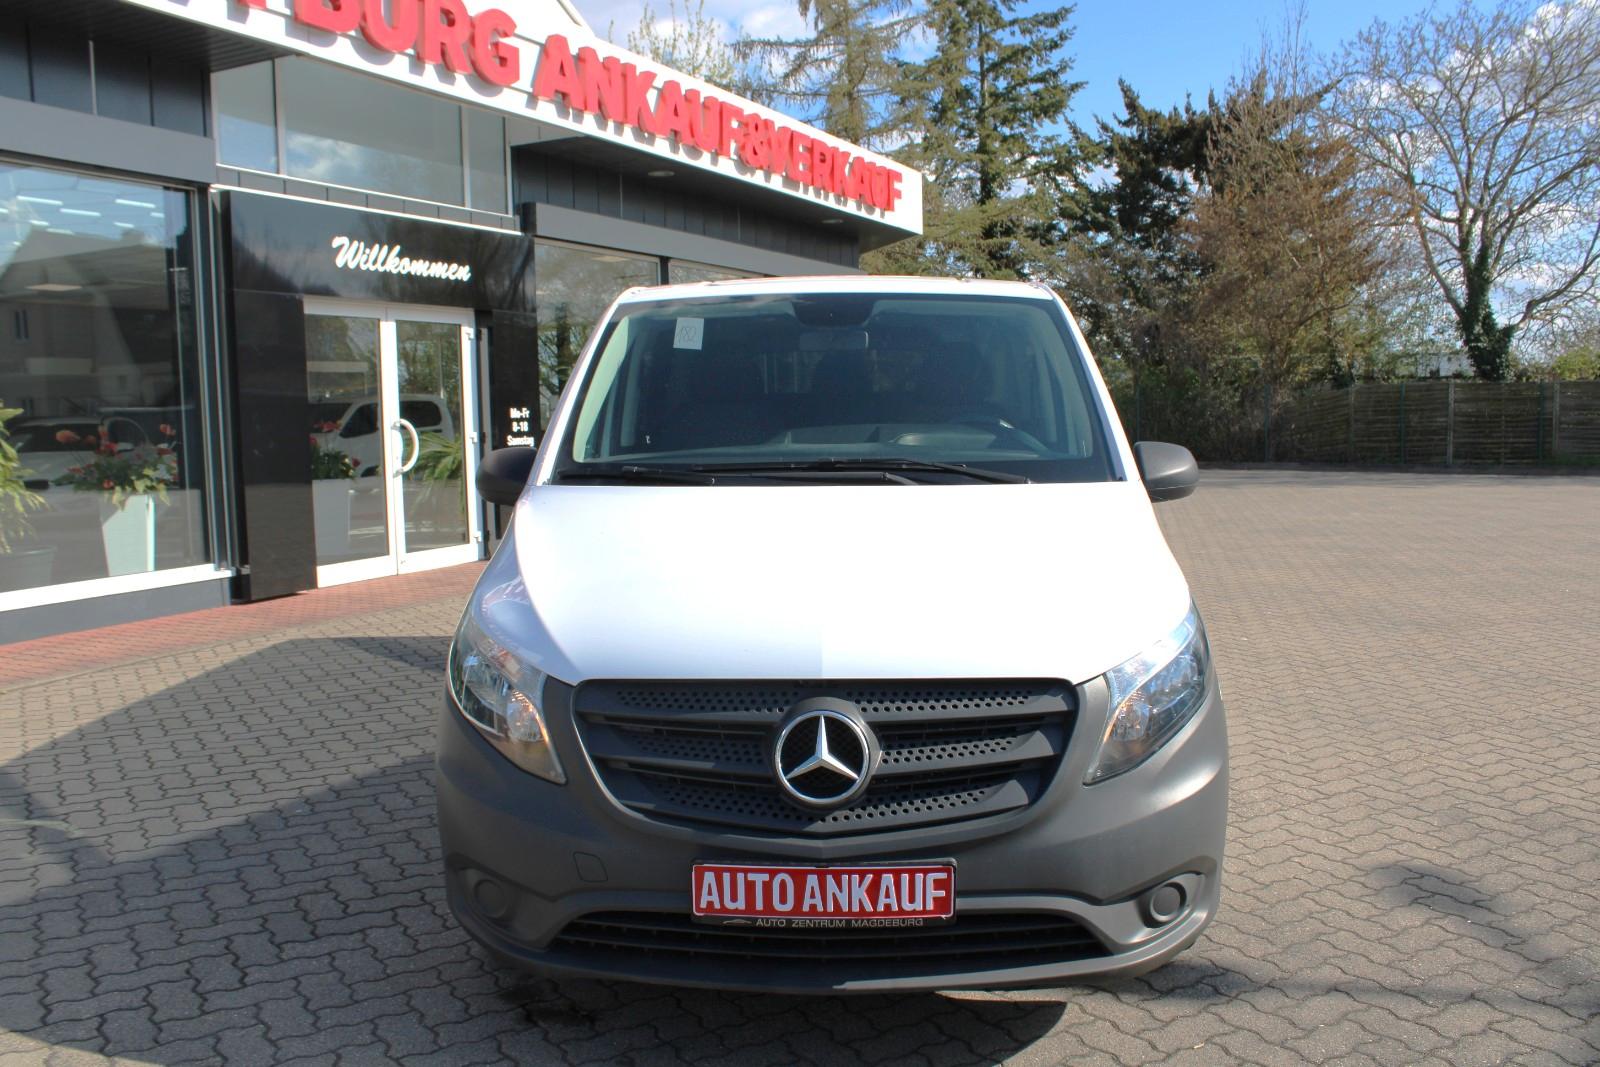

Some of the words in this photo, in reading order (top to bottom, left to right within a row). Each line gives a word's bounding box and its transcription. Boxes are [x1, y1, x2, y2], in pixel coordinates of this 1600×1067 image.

[237, 0, 520, 86] URG
[332, 236, 471, 281] Willkommen
[512, 421, 529, 432] 8-18
[700, 871, 794, 912] AUTO
[803, 872, 948, 912] ANKAUF
[755, 918, 787, 927] AUTO
[792, 919, 846, 928] ZENTRUM
[851, 918, 923, 927] MAGDEBURG
